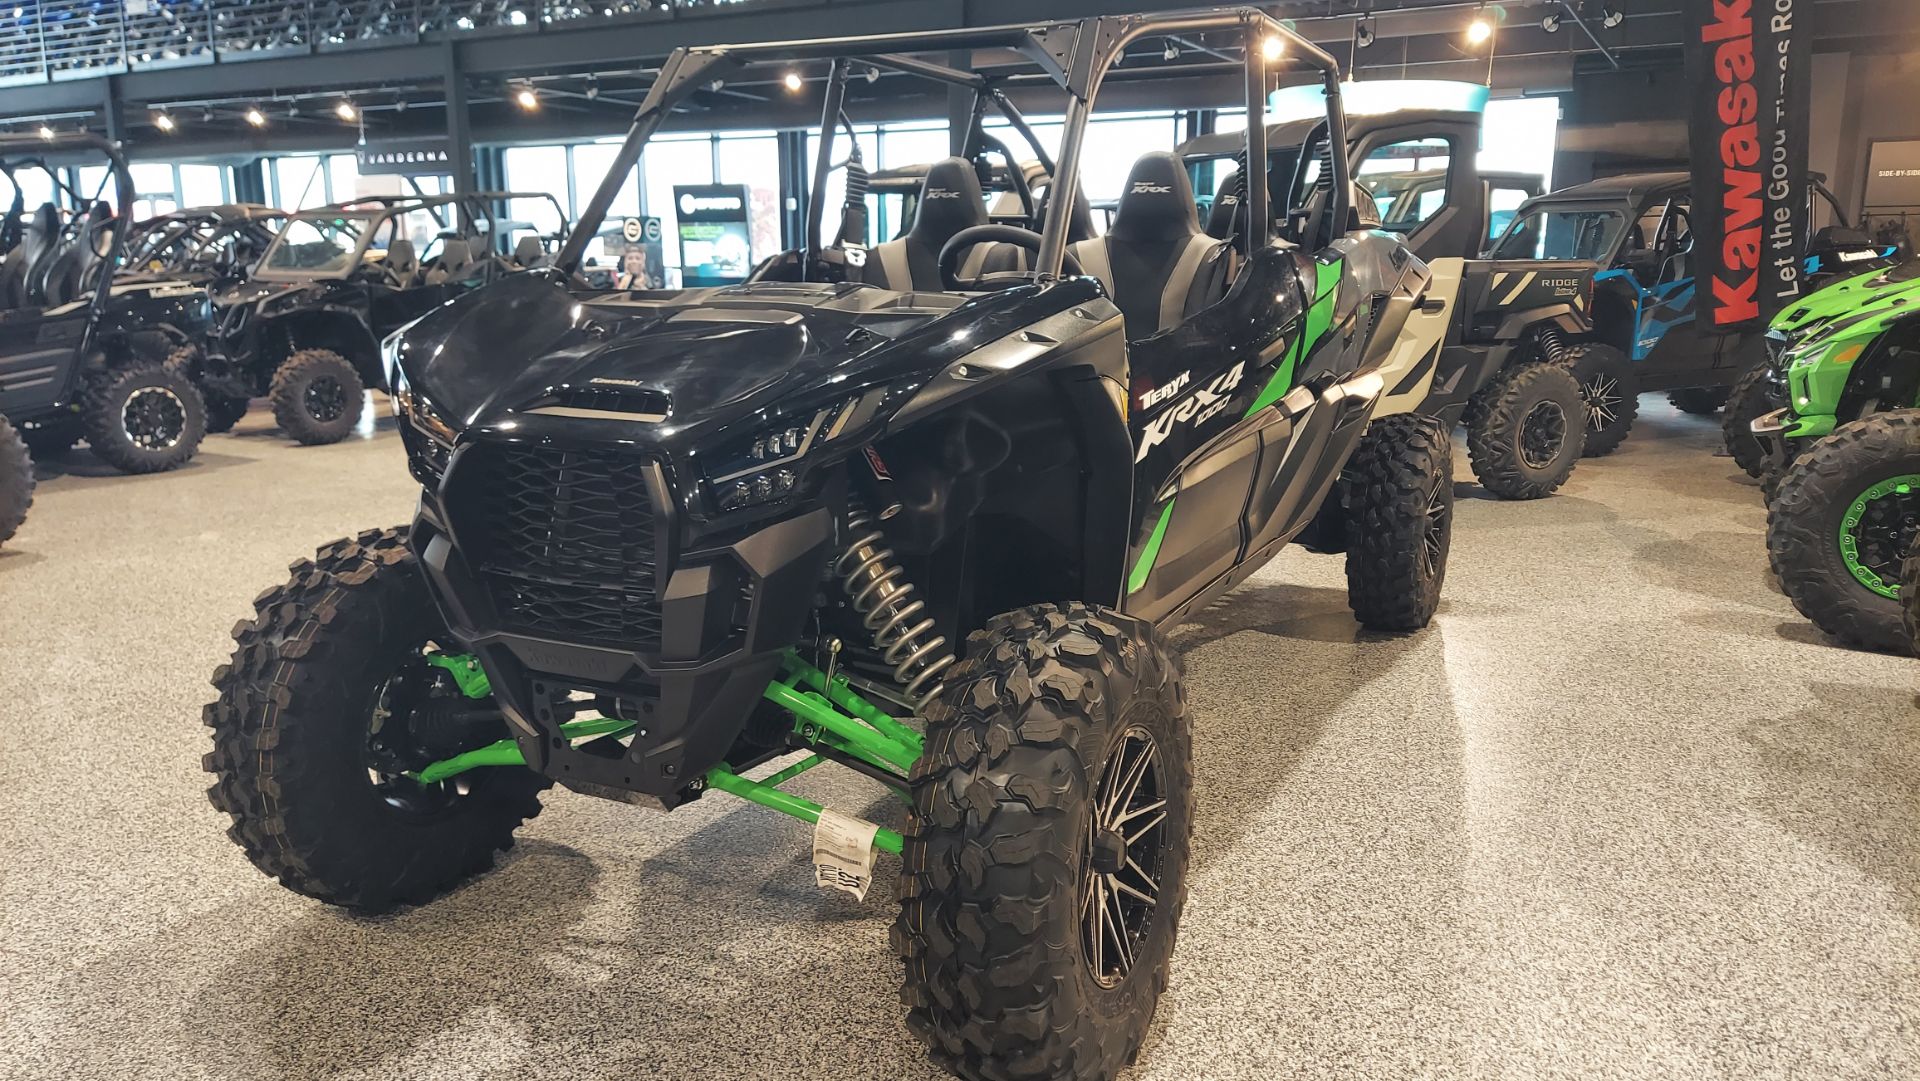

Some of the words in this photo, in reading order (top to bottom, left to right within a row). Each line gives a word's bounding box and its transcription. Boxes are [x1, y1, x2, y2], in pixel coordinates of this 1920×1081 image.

[1769, 206, 1793, 250] the
[1541, 278, 1579, 287] RIDGE
[1774, 255, 1800, 299] Let
[1194, 393, 1233, 429] 1000
